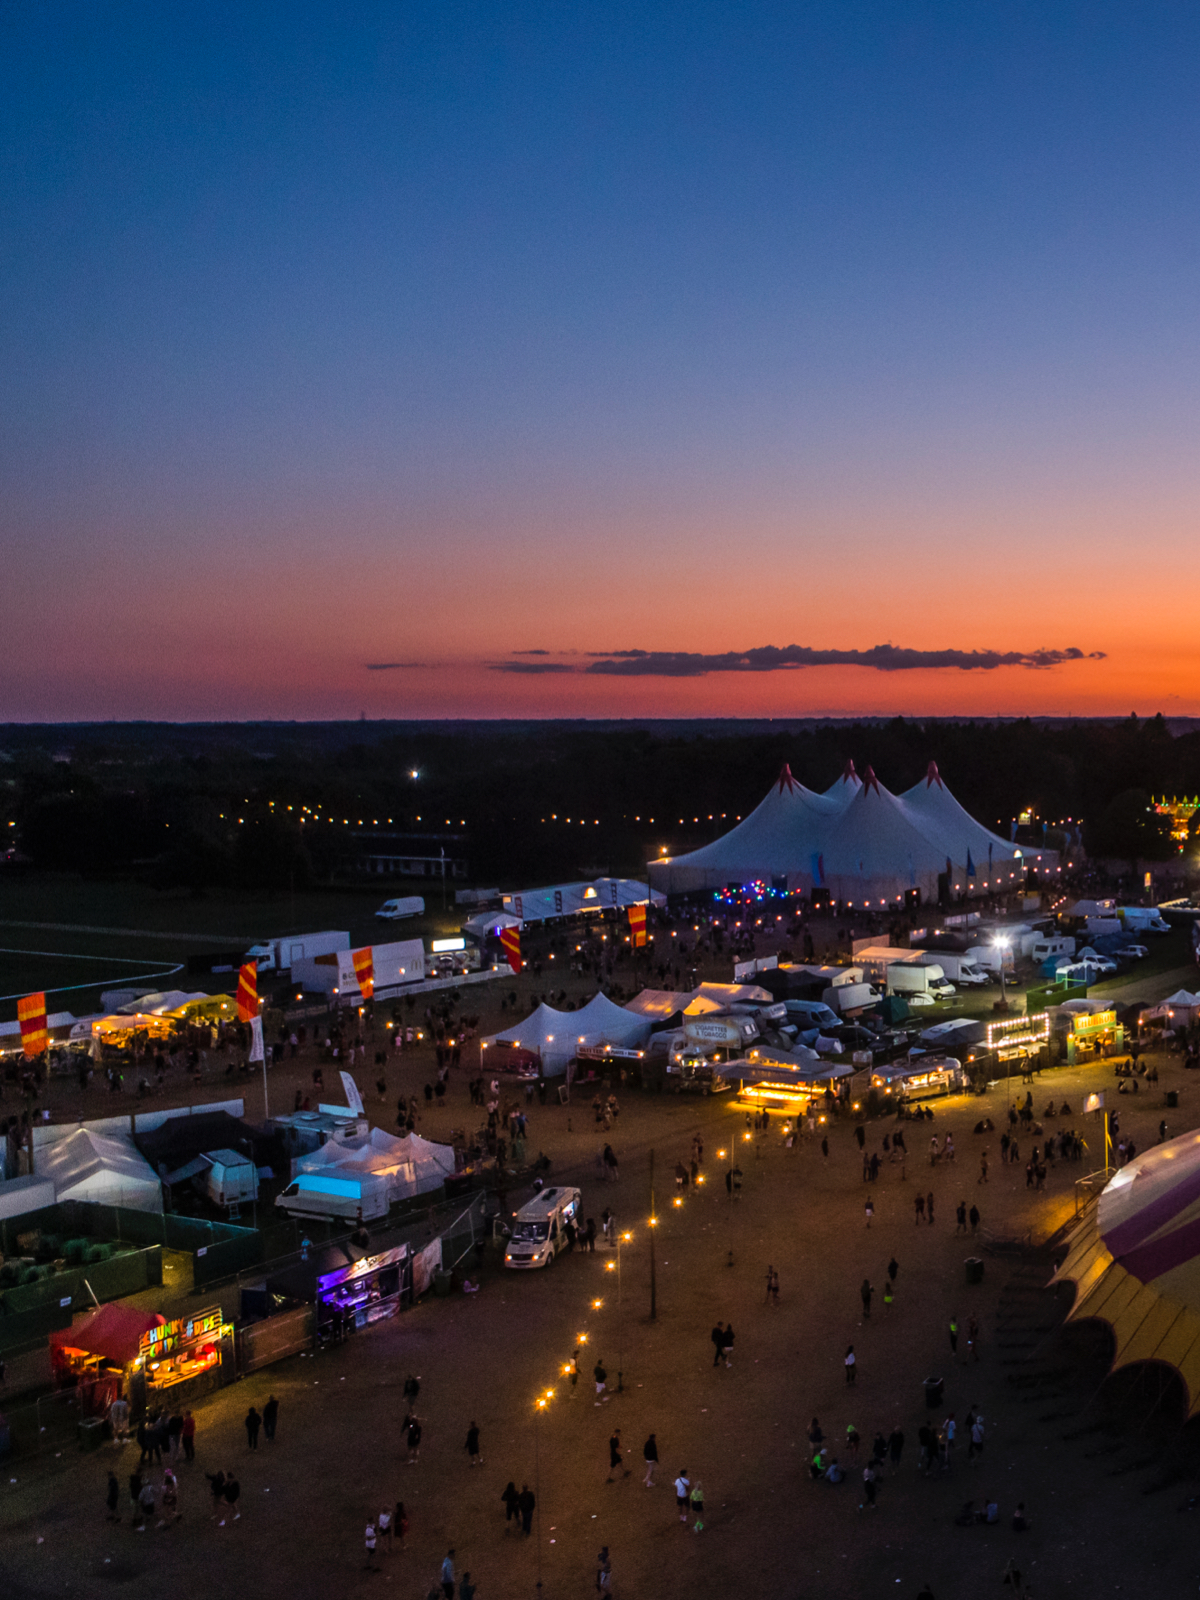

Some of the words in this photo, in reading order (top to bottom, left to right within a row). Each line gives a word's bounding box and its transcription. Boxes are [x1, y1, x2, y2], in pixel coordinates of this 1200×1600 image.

[1076, 1012, 1115, 1029] CHURROS
[695, 1024, 727, 1033] CIGARETTES
[701, 1030, 727, 1039] TOBACCO
[142, 1317, 184, 1346] CHUNKY
